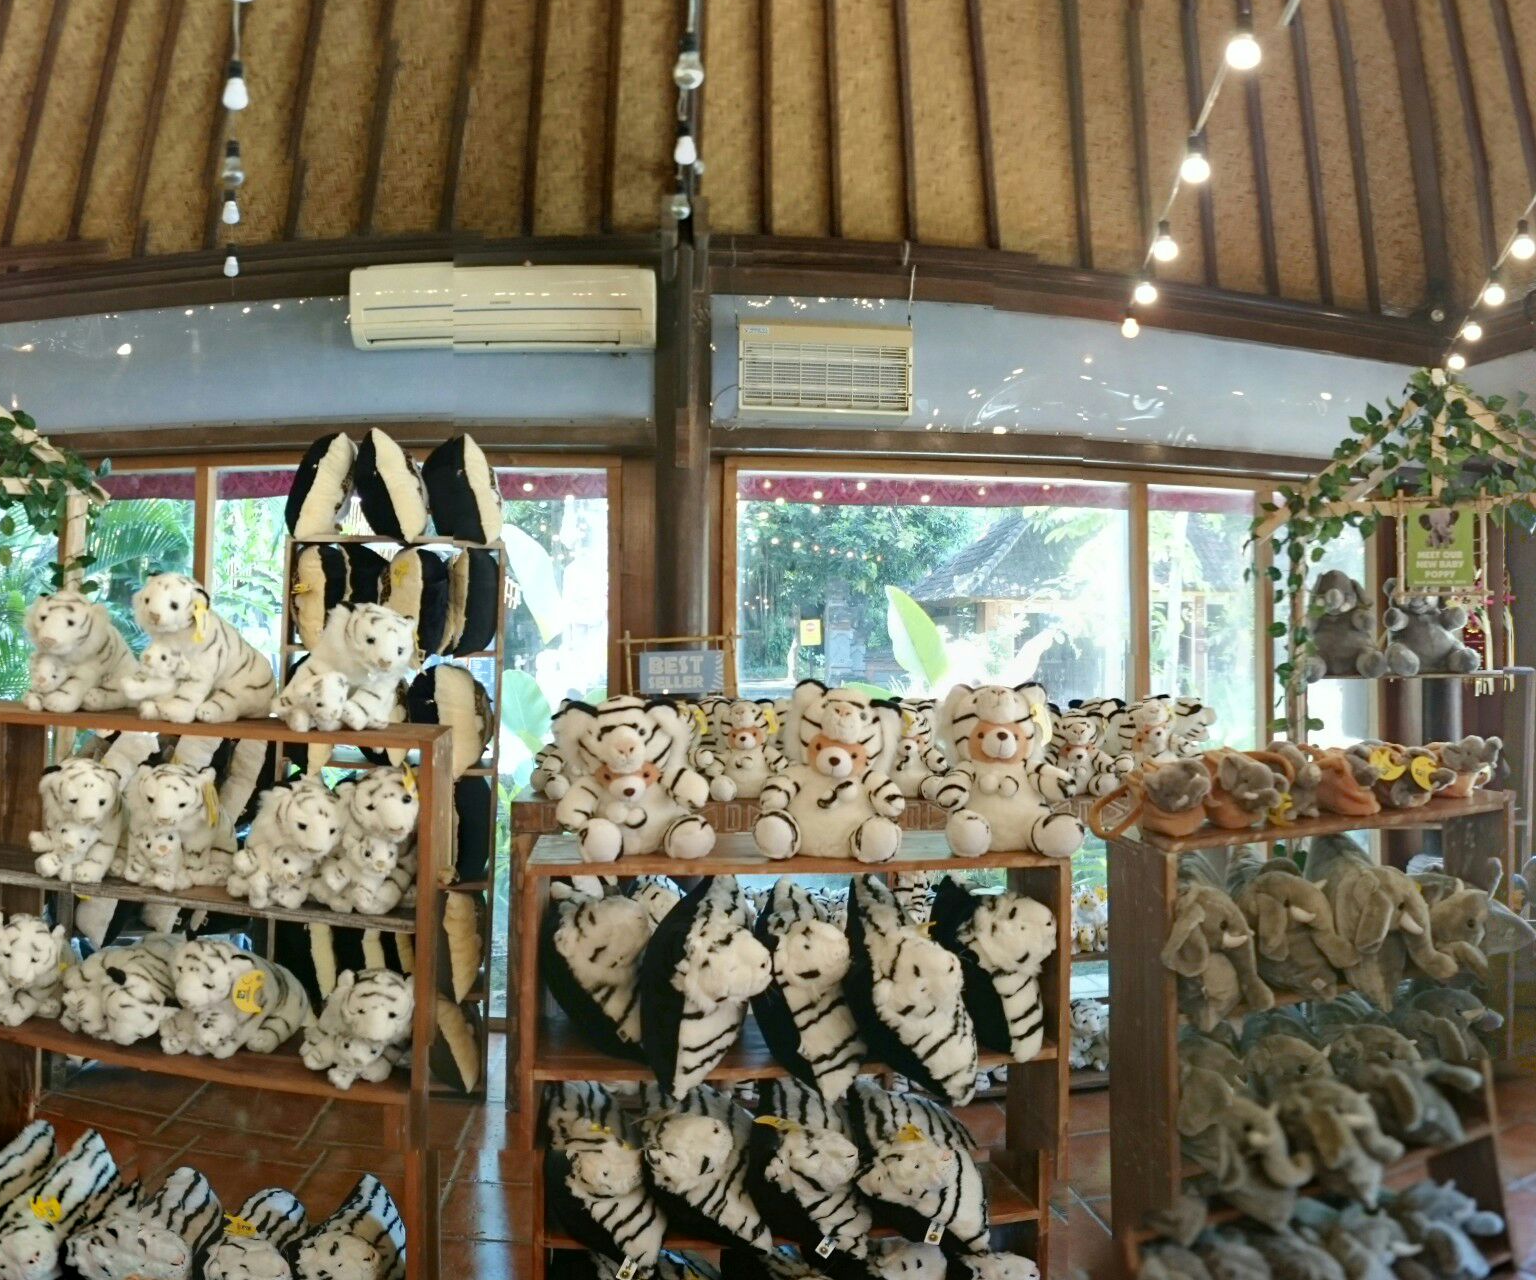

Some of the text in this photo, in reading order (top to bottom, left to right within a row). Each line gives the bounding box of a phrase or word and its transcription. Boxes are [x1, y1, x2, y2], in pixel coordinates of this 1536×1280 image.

[1439, 560, 1465, 568] BABY
[1424, 570, 1456, 578] POPPY
[648, 656, 704, 675] BEST
[648, 675, 704, 689] SELLER
